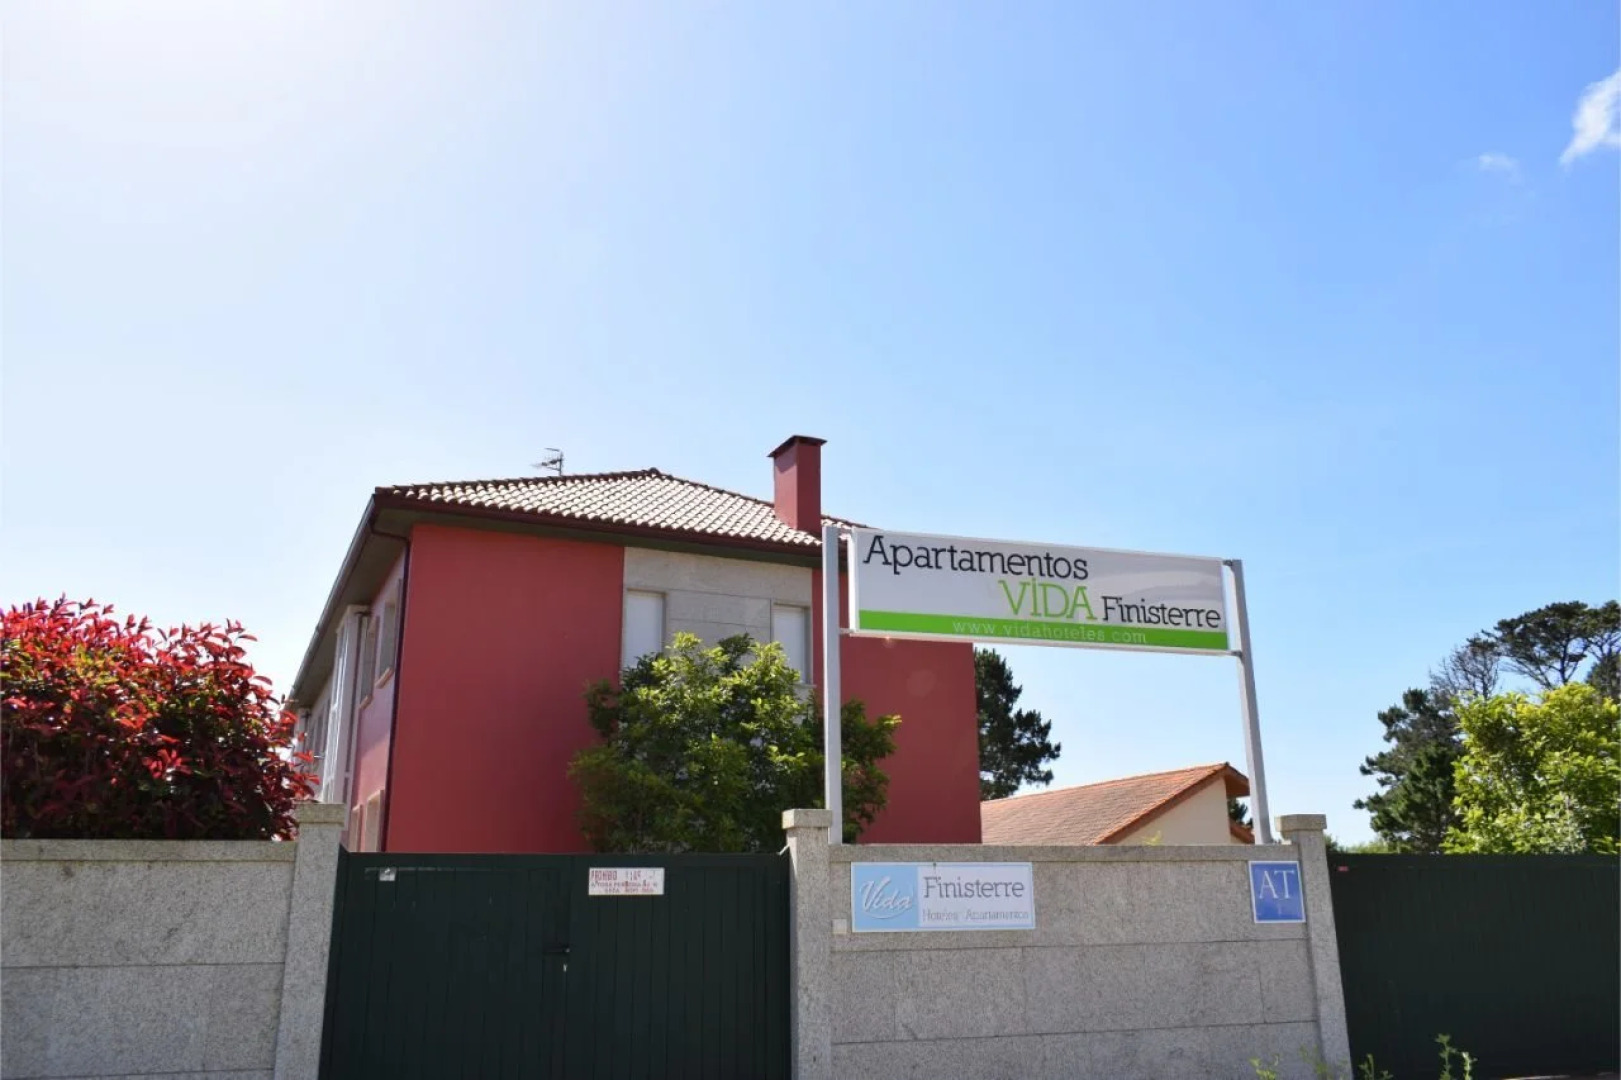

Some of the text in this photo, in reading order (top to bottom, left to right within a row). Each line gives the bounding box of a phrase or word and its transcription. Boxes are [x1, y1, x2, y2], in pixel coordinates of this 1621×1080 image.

[863, 535, 1089, 580] Apartamentos
[1101, 596, 1221, 629] Finisterre
[860, 876, 913, 912] Vida
[923, 876, 1025, 899] Finisterre
[1259, 870, 1295, 899] AT
